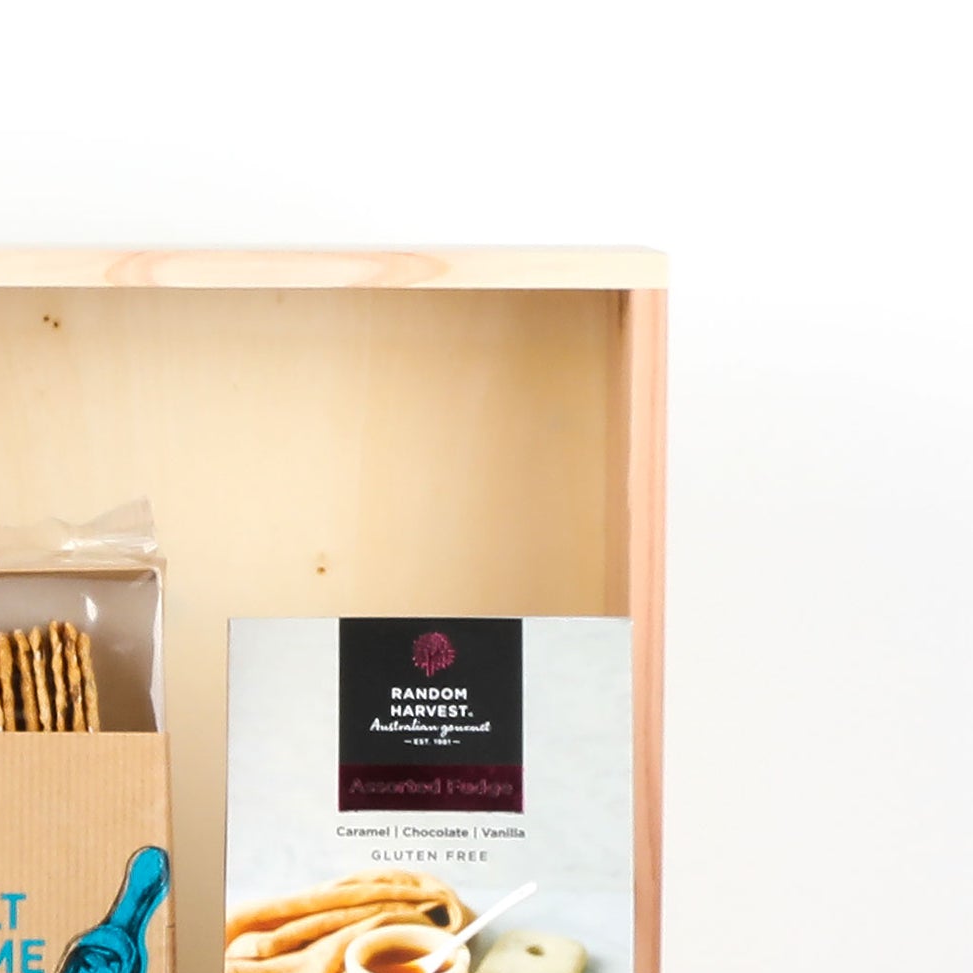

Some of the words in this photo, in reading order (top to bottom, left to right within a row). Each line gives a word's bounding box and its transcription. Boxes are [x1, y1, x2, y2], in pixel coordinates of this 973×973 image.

[391, 688, 467, 700] RANDOM
[370, 718, 438, 732] Australian
[440, 721, 491, 738] gourmet
[349, 778, 441, 794] Assorted
[447, 779, 513, 797] Fudge
[336, 826, 390, 838] Caramel
[403, 826, 469, 838] Chocolate
[482, 826, 525, 838] Vanilla
[371, 850, 438, 862] GLUTEN
[446, 850, 489, 862] FREE
